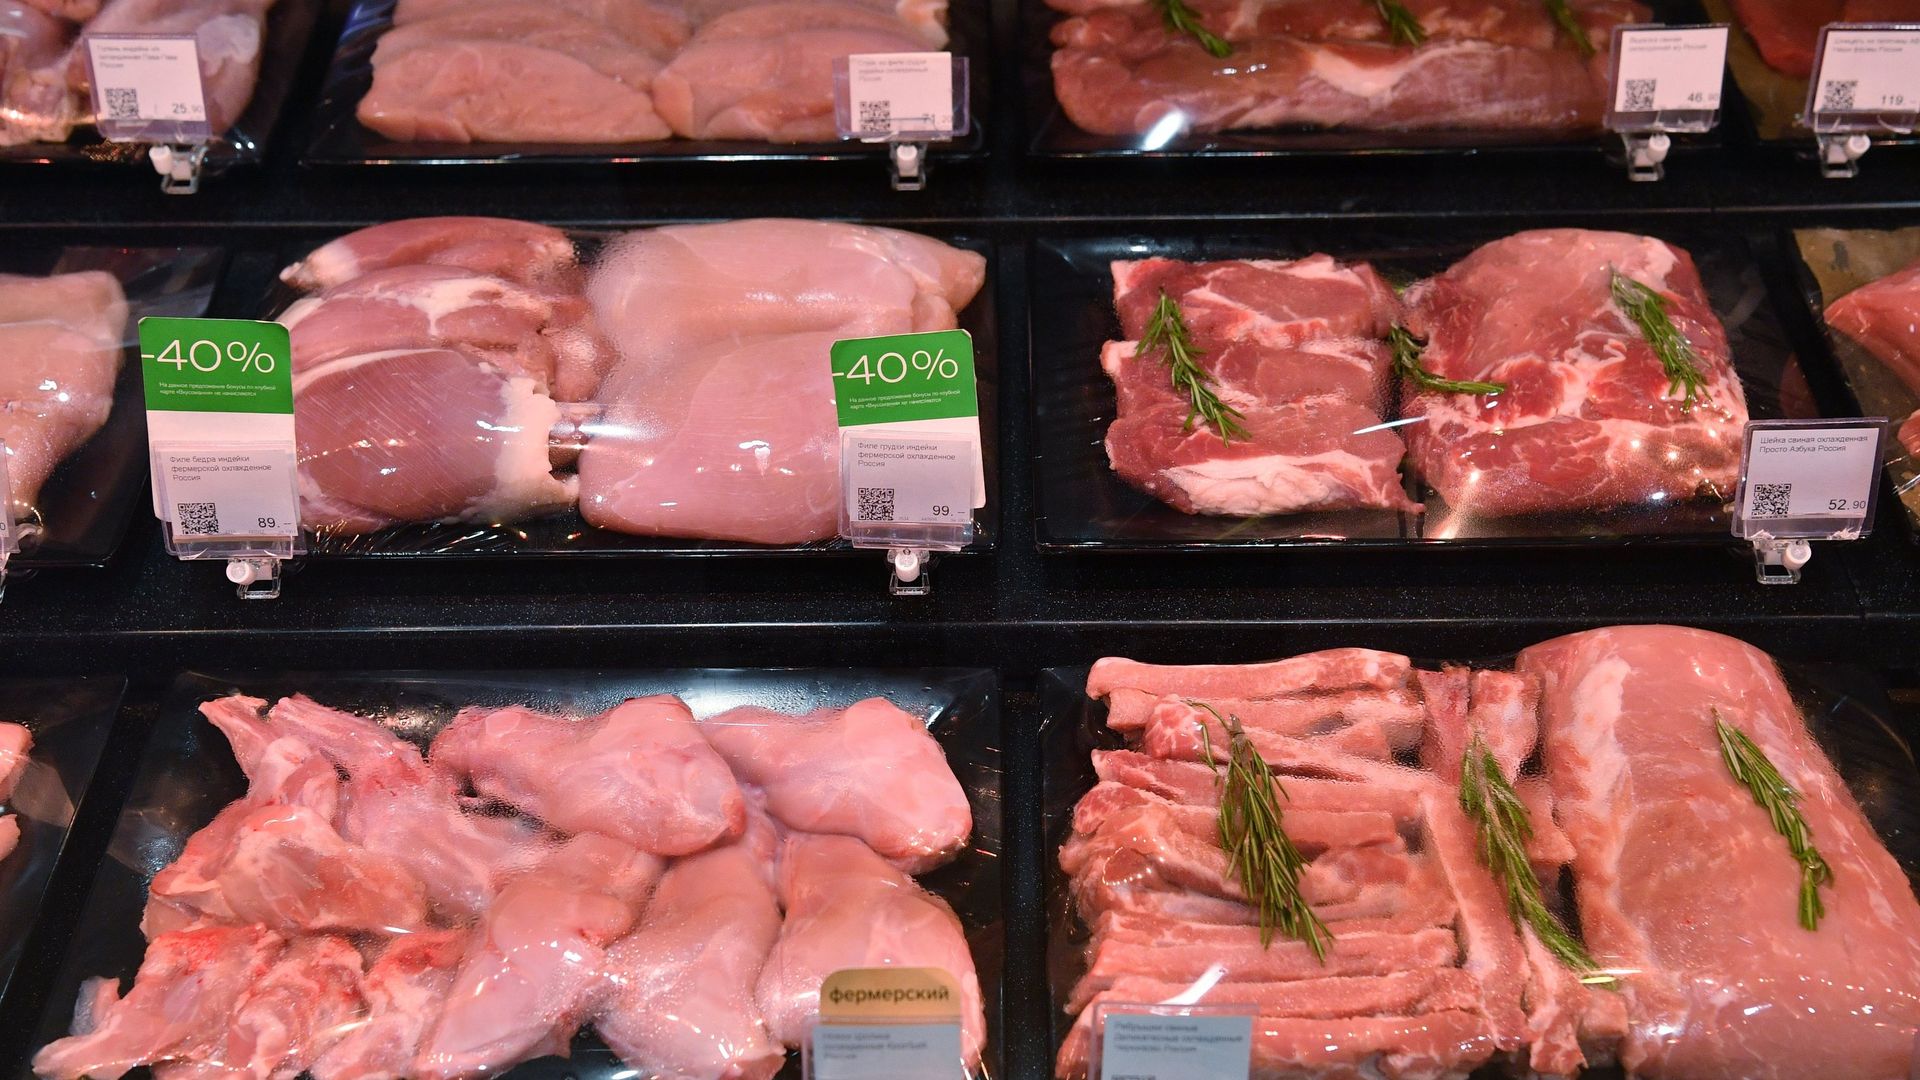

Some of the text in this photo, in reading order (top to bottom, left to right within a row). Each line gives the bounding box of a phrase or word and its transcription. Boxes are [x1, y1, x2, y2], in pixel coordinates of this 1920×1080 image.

[141, 339, 275, 373] -40%
[832, 348, 959, 385] -40%
[1760, 436, 1786, 444] Шейка
[1817, 435, 1868, 443] охлажденная
[879, 443, 905, 451] грудки
[1790, 445, 1816, 454] Азбука
[169, 455, 250, 463] Филе бедра индейки
[857, 451, 956, 461] фермерской охлажденное
[857, 459, 885, 467] Россия
[171, 464, 272, 473] фермерской охлажденное
[829, 985, 950, 1005] фермерский
